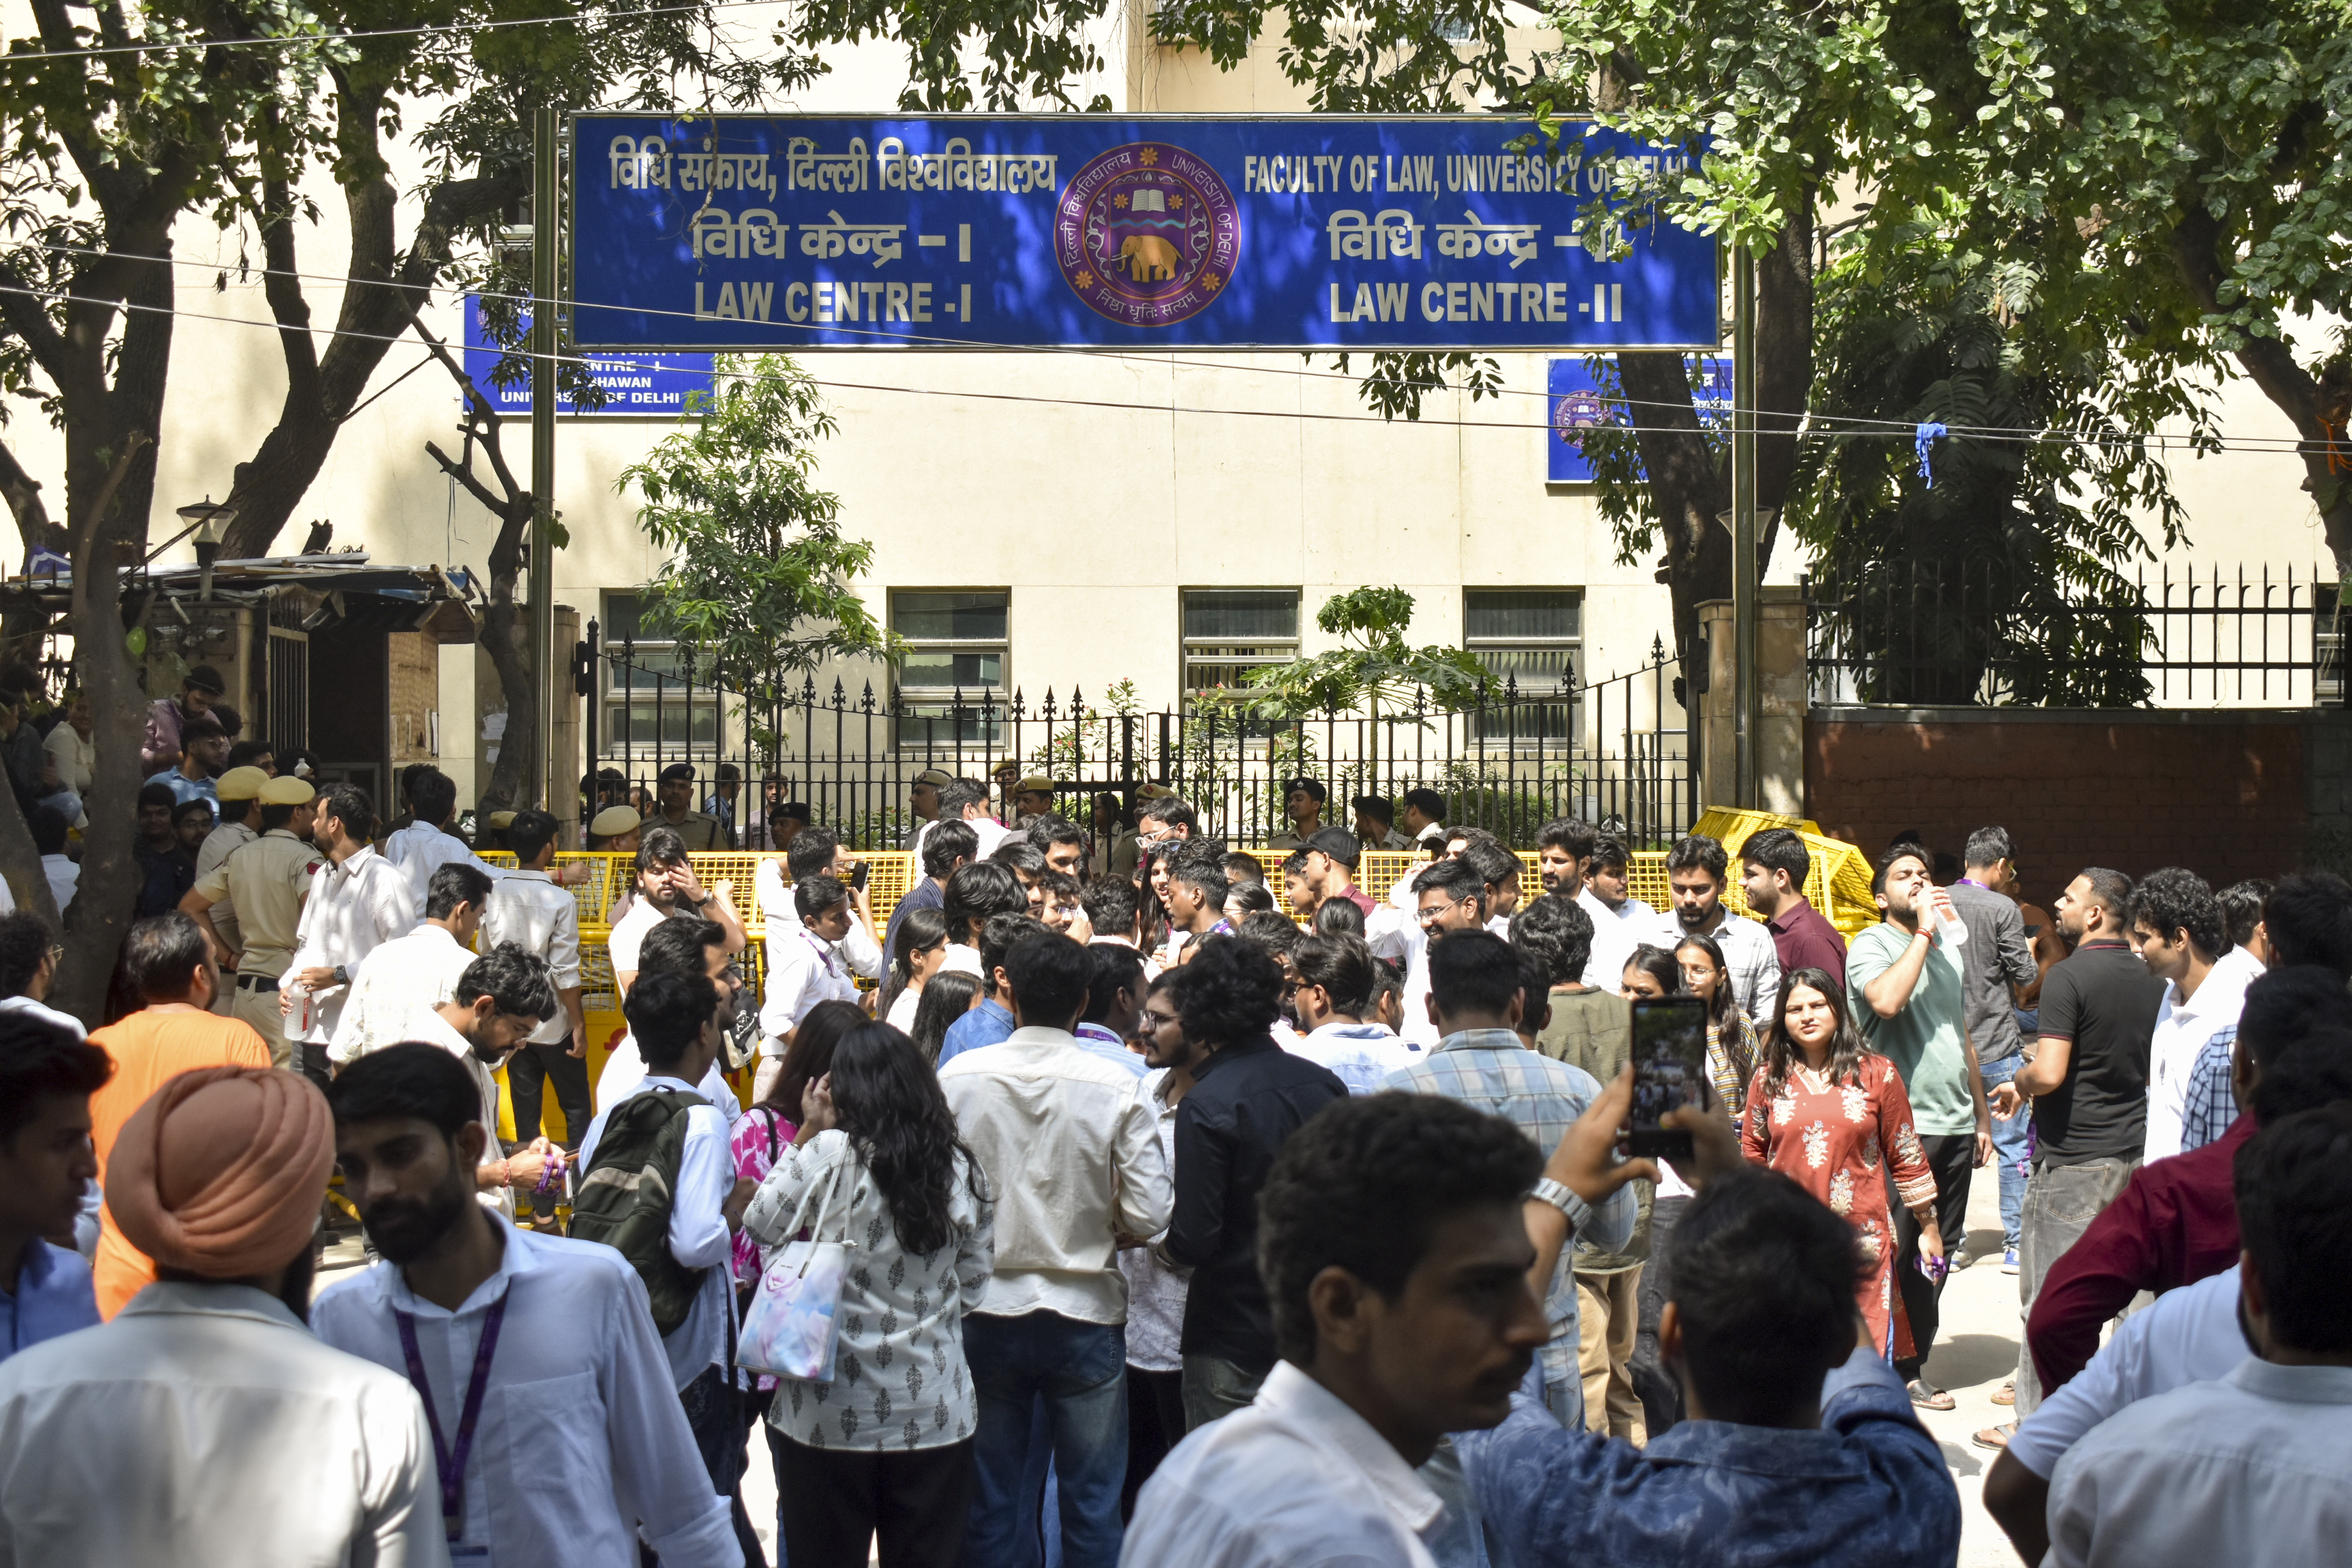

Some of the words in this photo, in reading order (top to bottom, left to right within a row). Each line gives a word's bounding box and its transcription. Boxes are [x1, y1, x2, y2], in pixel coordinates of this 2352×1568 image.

[609, 136, 673, 190] विधि
[786, 137, 870, 193] दिल्ली
[877, 137, 1057, 194] विश्वविद्यालय
[1172, 154, 1227, 208] UNIVERSITY
[1245, 155, 1343, 193] FACULTY
[1350, 155, 1378, 193] OF
[1386, 155, 1439, 200] LAW,
[1447, 155, 1581, 193] UNIVERSITY
[693, 208, 789, 260] विधि
[799, 210, 906, 269] केन्द्र
[1217, 213, 1232, 229] OF
[1326, 209, 1425, 260] विधि
[1436, 210, 1541, 270] केन्द्र
[1213, 233, 1232, 268] DELHI
[695, 282, 774, 322] LAW
[785, 282, 932, 322] CENTRE
[1330, 283, 1409, 322] LAW
[1421, 282, 1567, 322] CENTRE
[631, 392, 680, 403] DELHI
[1108, 1325, 1117, 1365] RSACE
